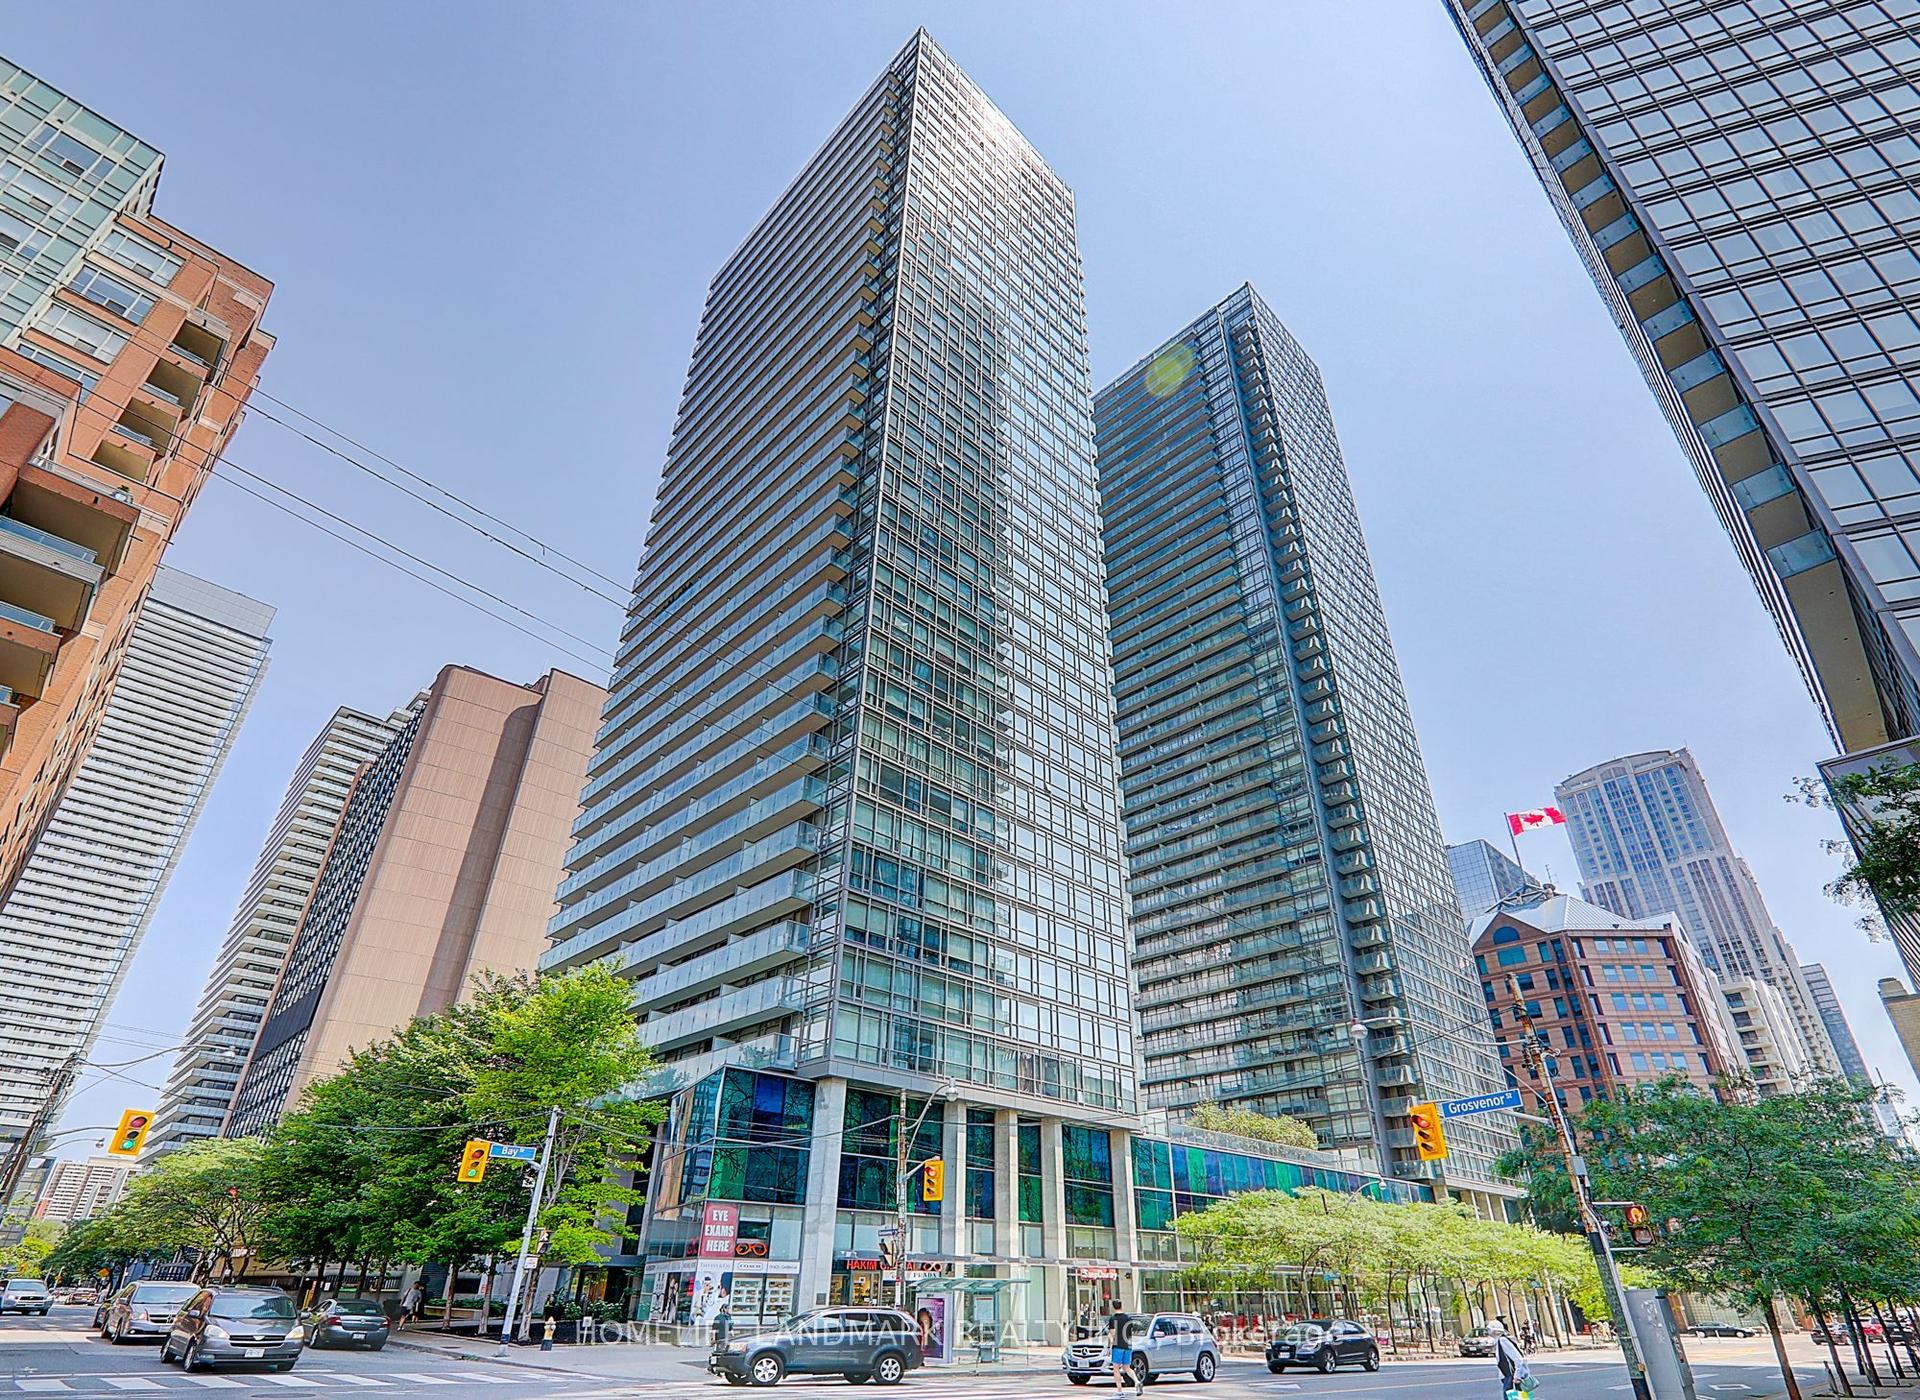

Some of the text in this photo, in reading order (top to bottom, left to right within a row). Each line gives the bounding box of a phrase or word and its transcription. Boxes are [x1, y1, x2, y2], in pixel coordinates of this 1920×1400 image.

[1448, 1095, 1504, 1114] Grosvenor
[501, 1146, 519, 1158] Bay
[712, 1209, 729, 1221] EYE
[704, 1224, 735, 1238] EXAMS
[706, 1239, 730, 1252] HERE
[846, 1259, 878, 1271] HAKIM
